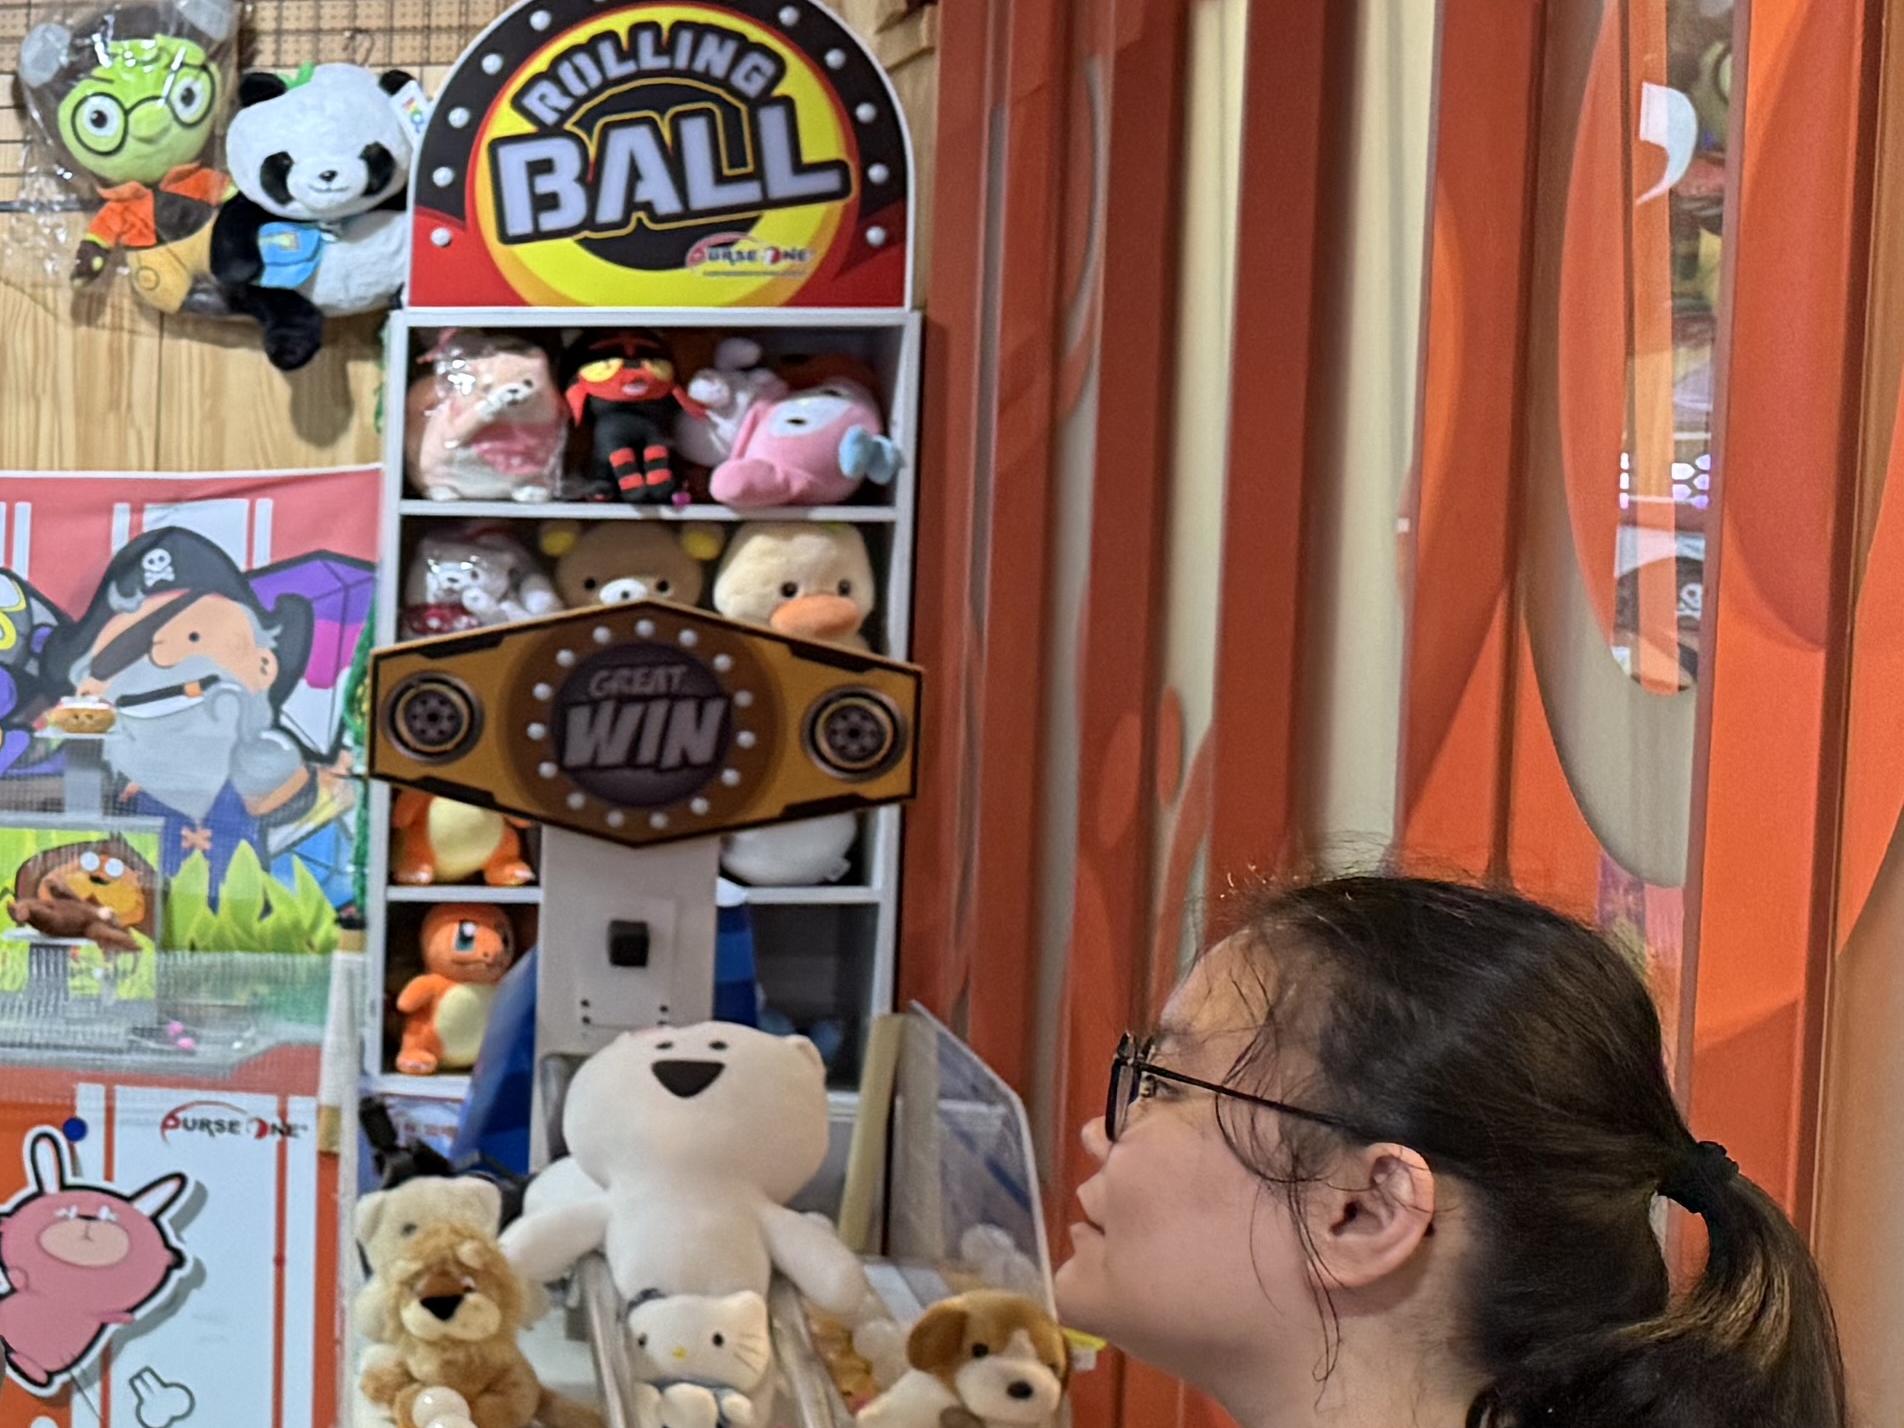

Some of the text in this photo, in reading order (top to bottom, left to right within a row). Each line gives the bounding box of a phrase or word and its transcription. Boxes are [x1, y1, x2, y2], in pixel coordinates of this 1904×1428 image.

[522, 27, 778, 126] ROLLING
[496, 105, 843, 236] BALL
[589, 664, 683, 698] GREAT
[562, 696, 729, 770] WIN
